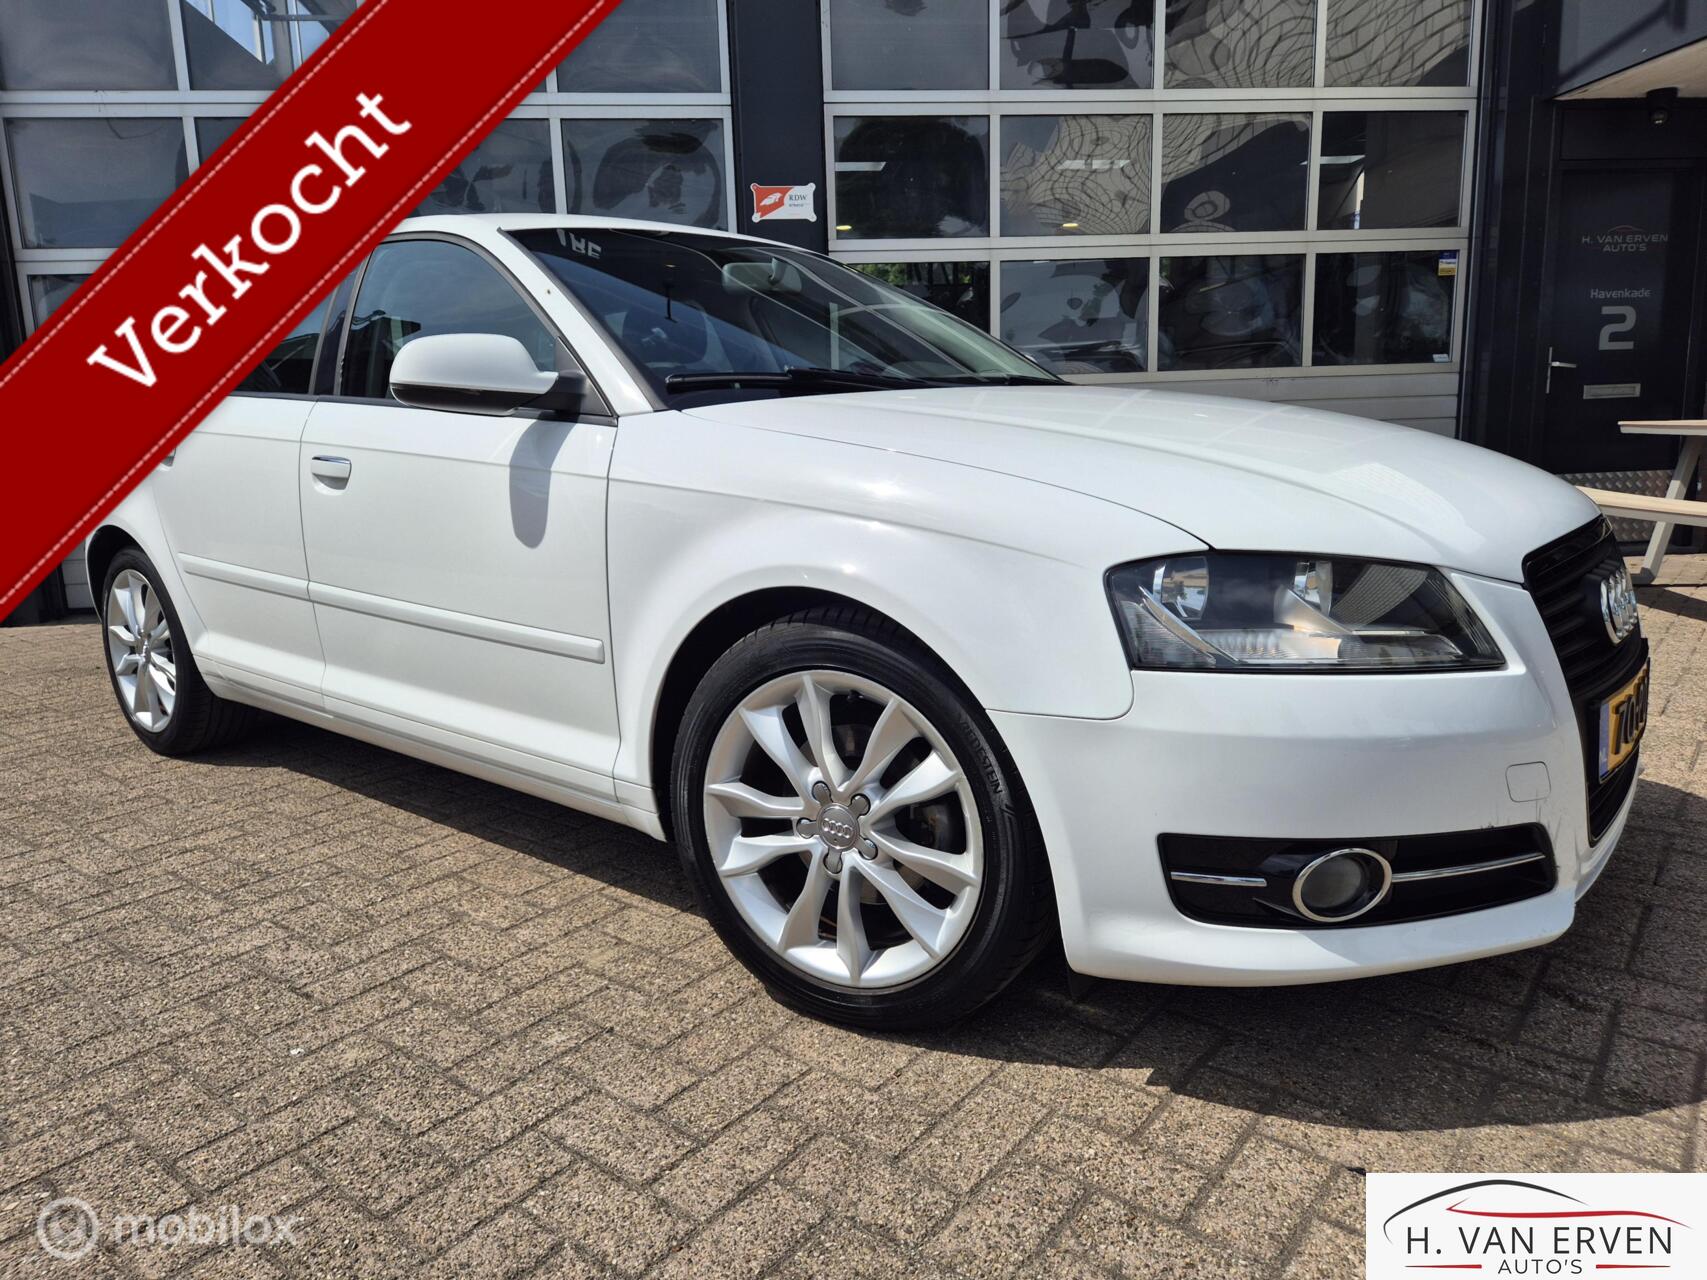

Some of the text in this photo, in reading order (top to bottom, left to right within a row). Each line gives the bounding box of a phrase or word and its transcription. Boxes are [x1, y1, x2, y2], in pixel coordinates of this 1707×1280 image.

[1581, 233, 1669, 244] H. VAN ERVEN
[1602, 243, 1647, 252] AUTO'S
[1590, 288, 1652, 299] Havenkade
[1598, 305, 1637, 351] 2
